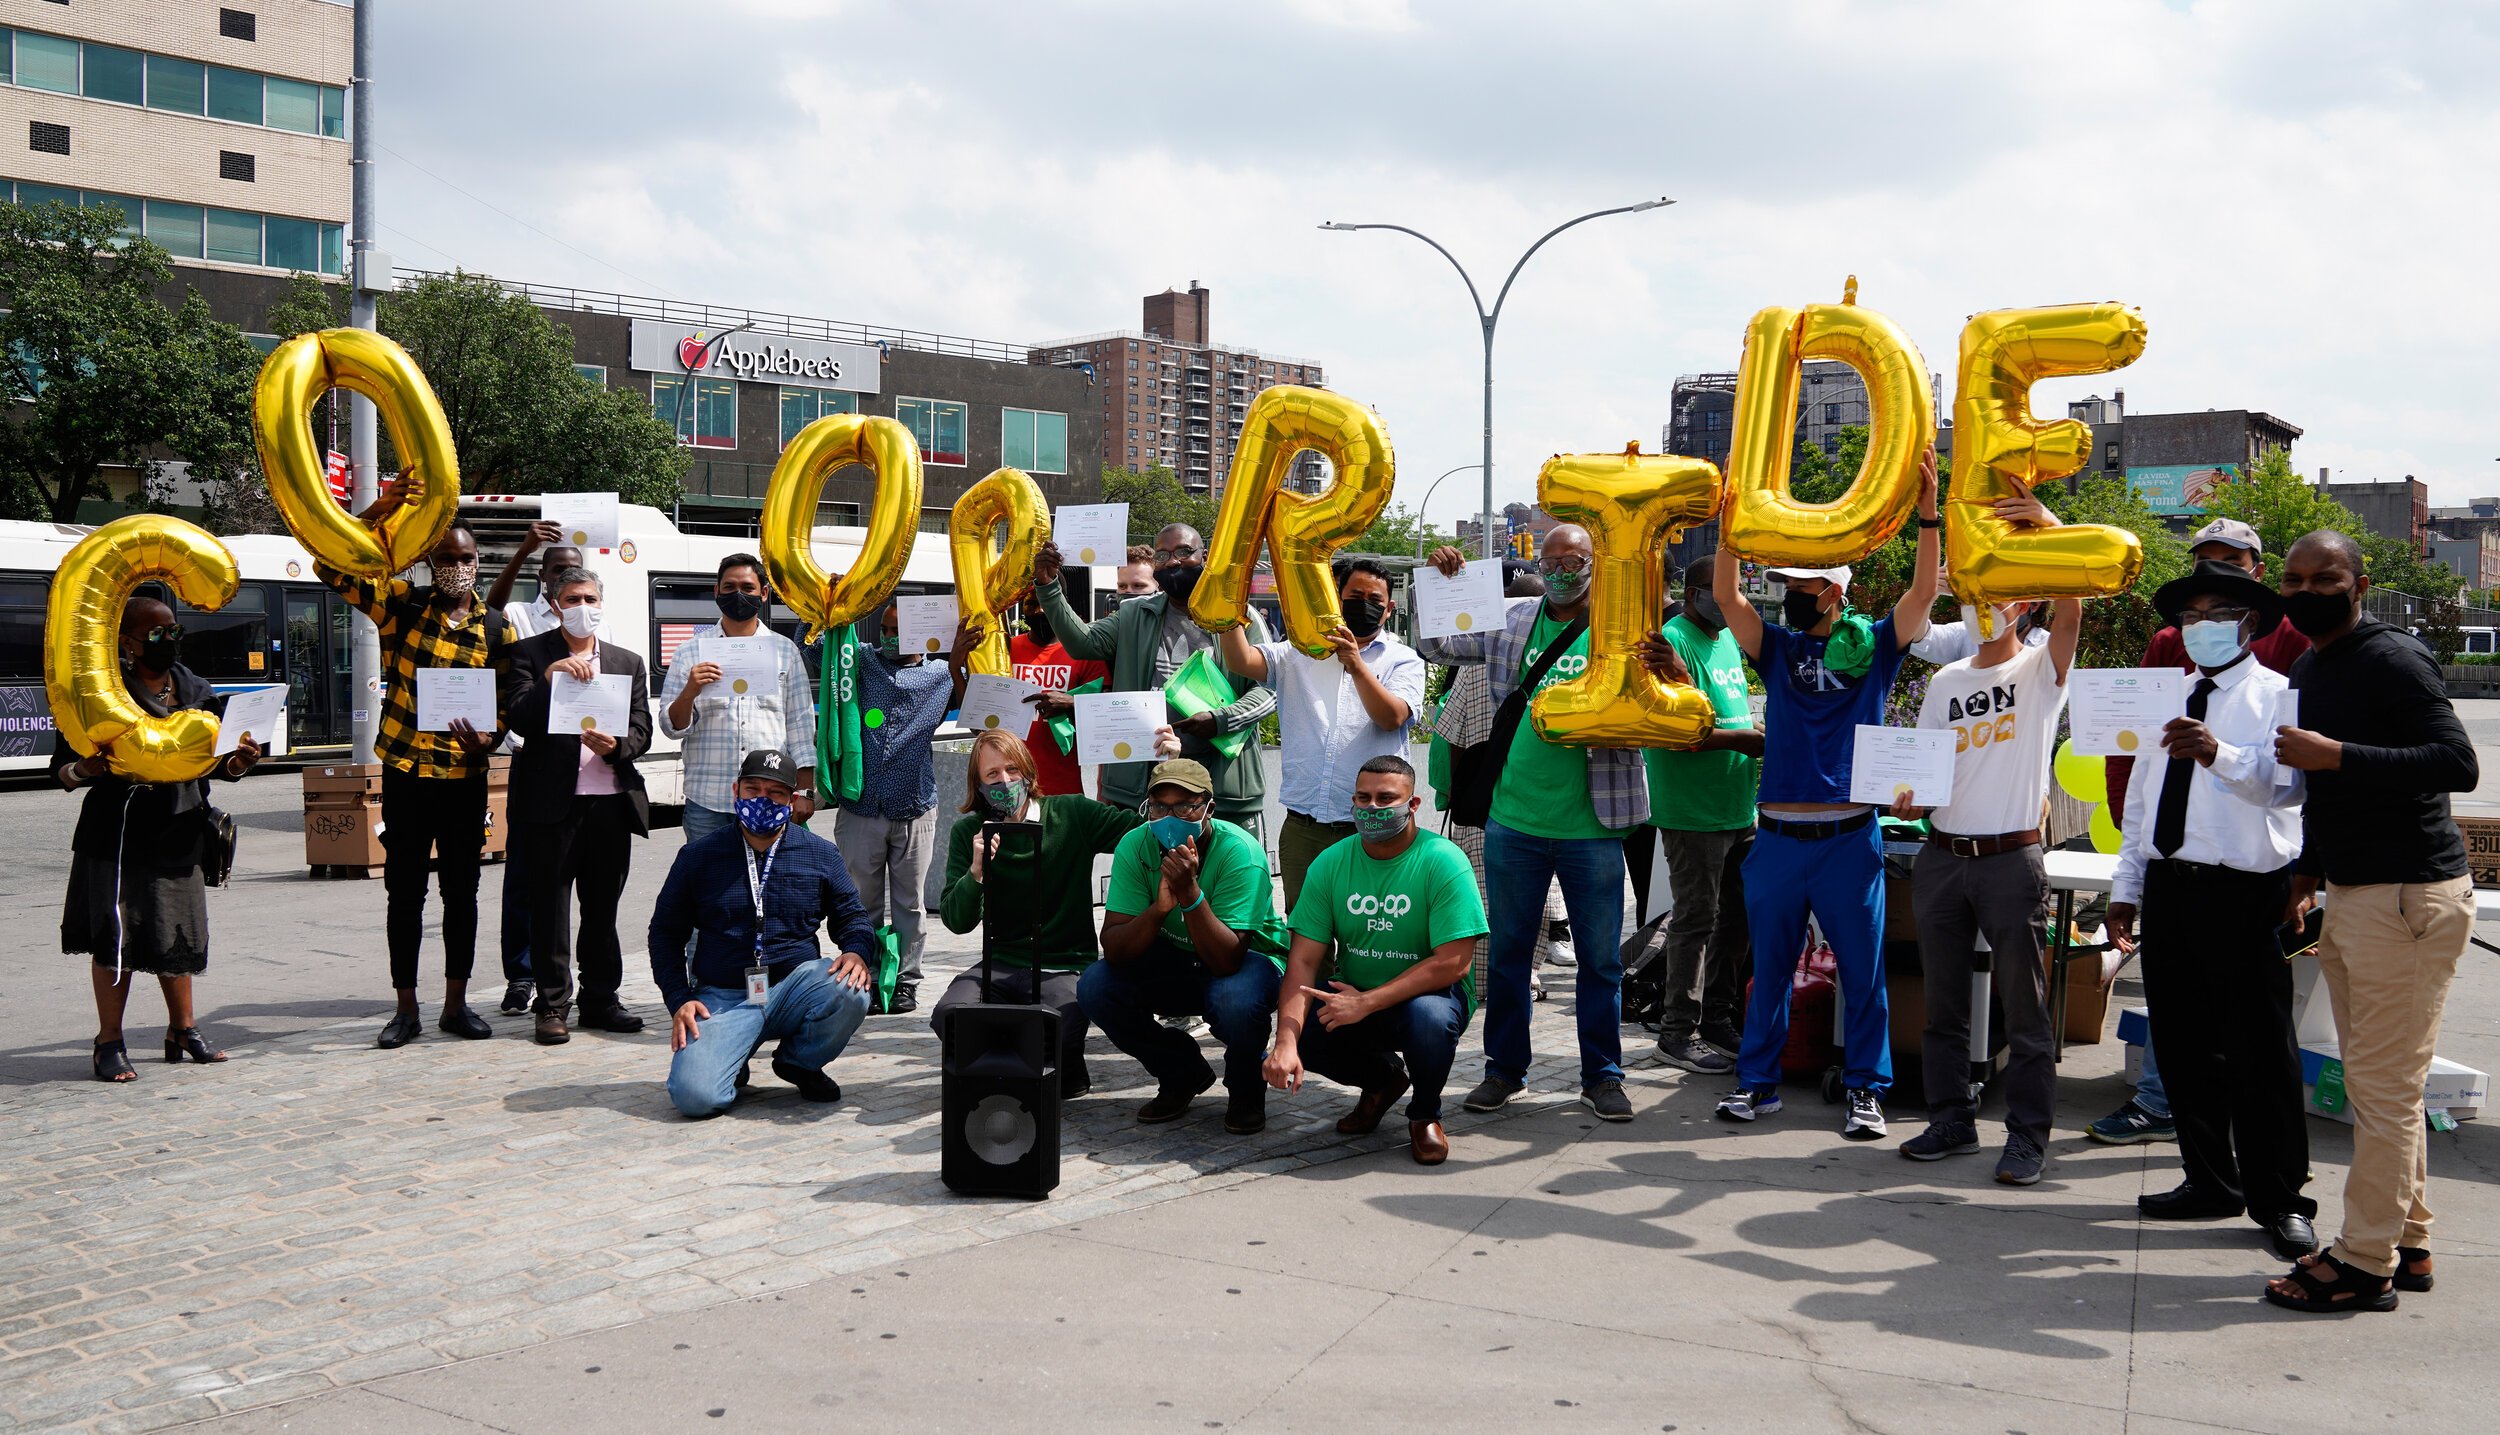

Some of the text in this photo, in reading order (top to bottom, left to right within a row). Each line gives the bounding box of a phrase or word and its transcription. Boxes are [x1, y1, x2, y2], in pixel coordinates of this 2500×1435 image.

[715, 336, 842, 379] Applebee's
[1364, 821, 1383, 830] Ride
[1372, 948, 1383, 959] by
